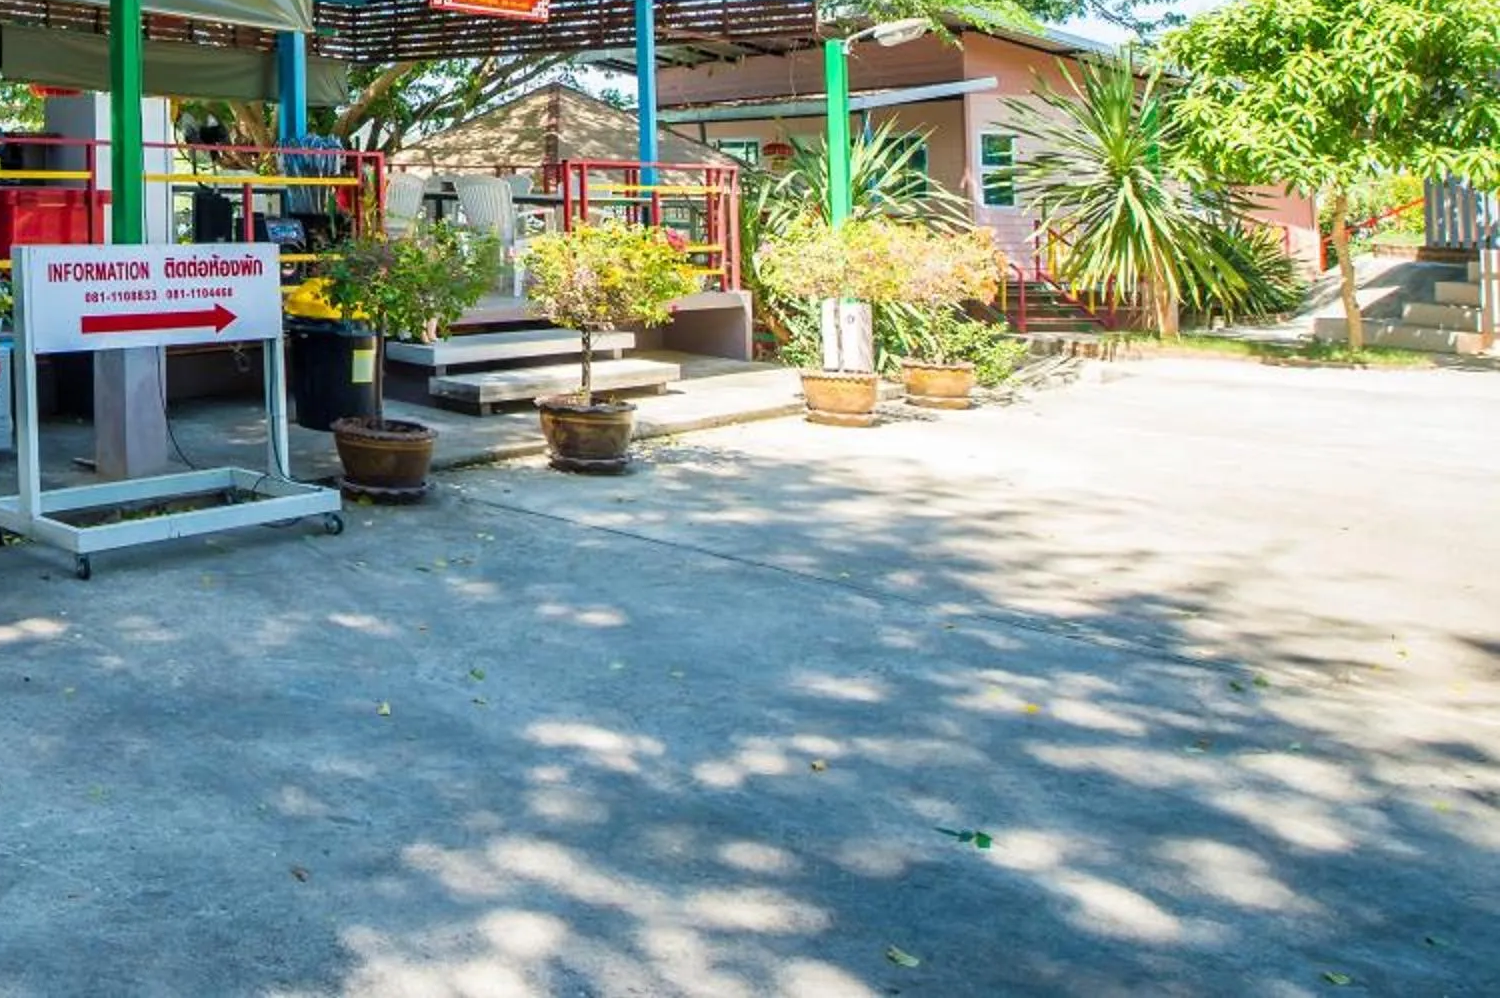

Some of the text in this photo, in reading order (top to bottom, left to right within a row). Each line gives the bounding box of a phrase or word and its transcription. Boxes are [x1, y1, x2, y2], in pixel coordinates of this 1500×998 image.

[47, 261, 150, 283] INFORMATION
[164, 253, 263, 279] ติดต่อห้องพัก
